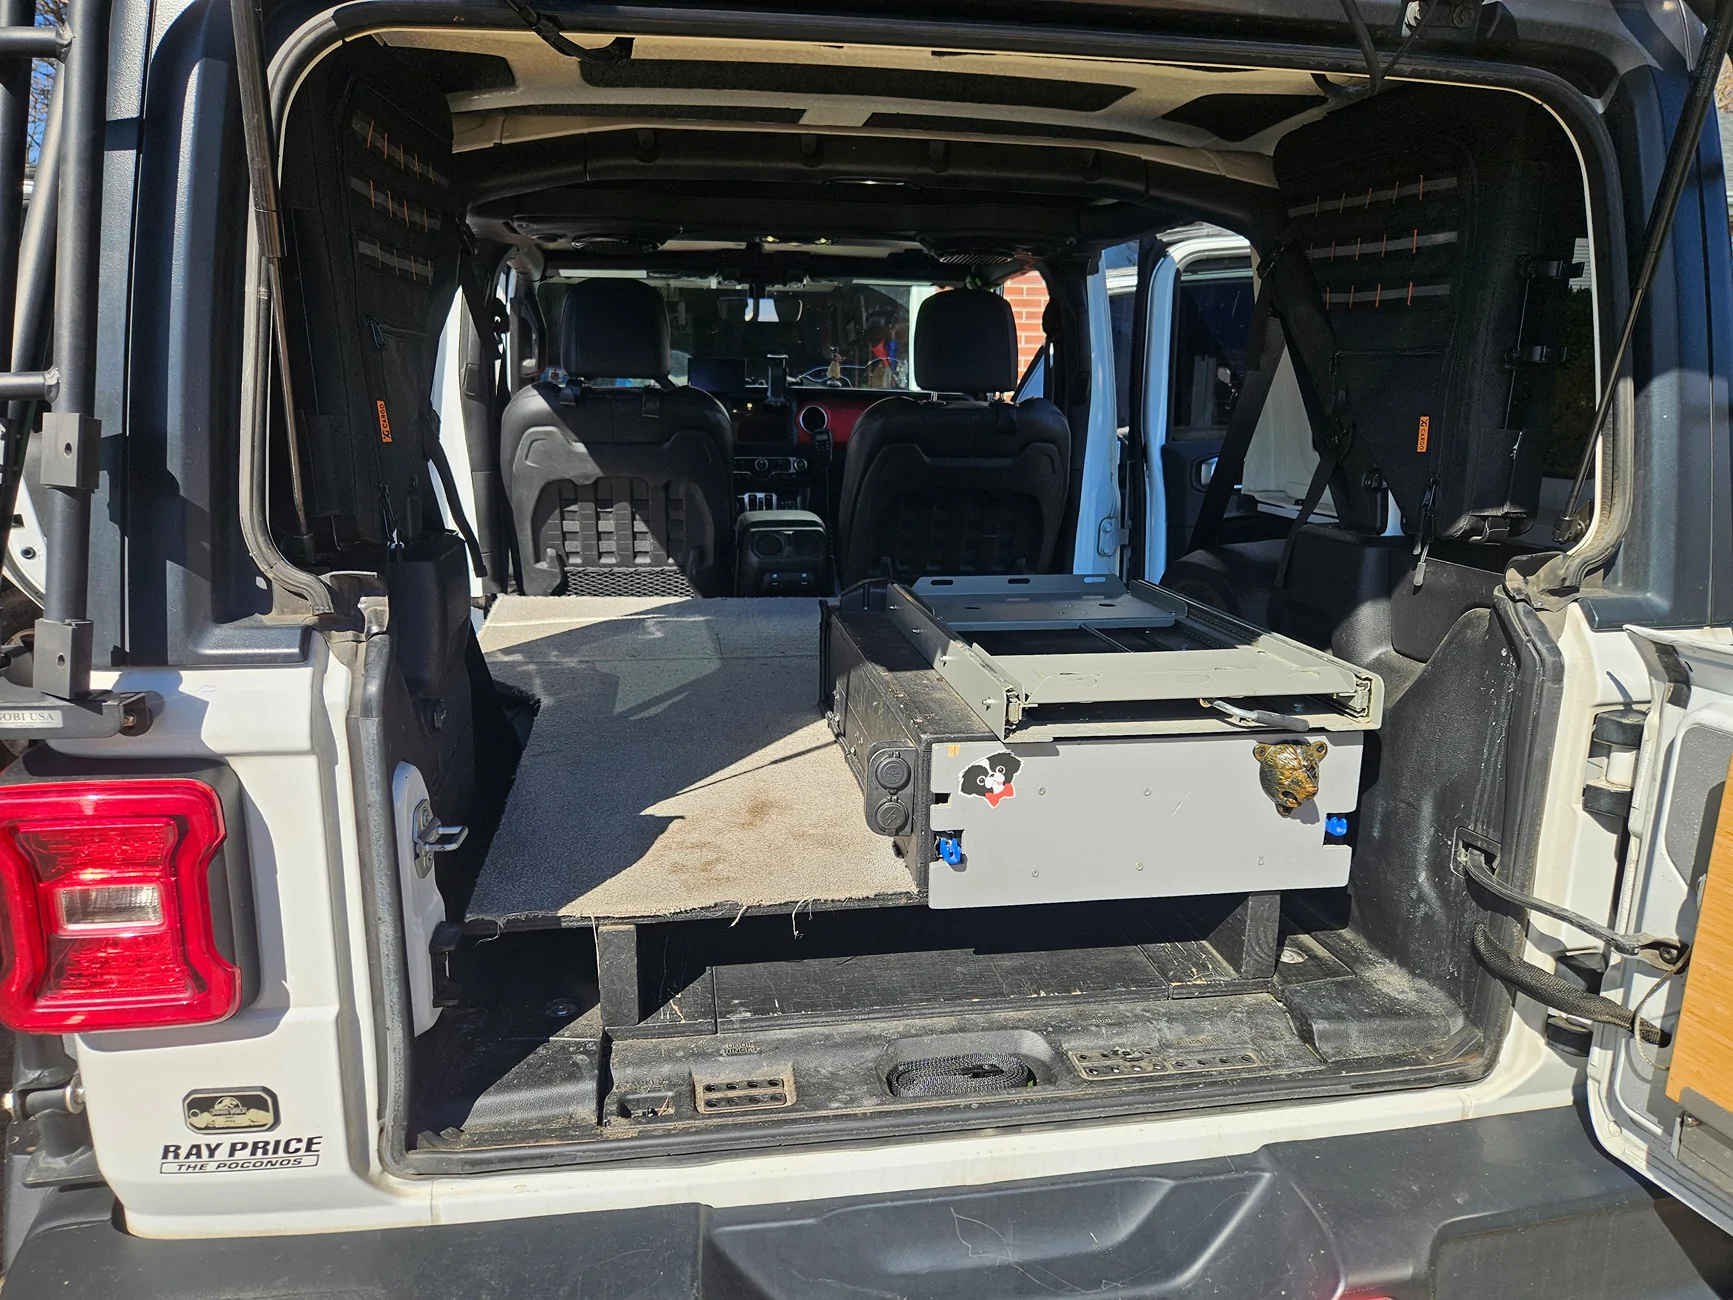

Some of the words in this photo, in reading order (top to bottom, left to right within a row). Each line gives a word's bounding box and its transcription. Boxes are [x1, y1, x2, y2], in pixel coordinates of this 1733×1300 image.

[380, 403, 388, 428] CARGO
[0, 712, 25, 721] OBI
[29, 712, 55, 721] USA
[161, 1143, 224, 1160] RAY
[228, 1136, 323, 1158] PRICE
[177, 1163, 208, 1171] THE
[216, 1158, 303, 1170] POCONOS
